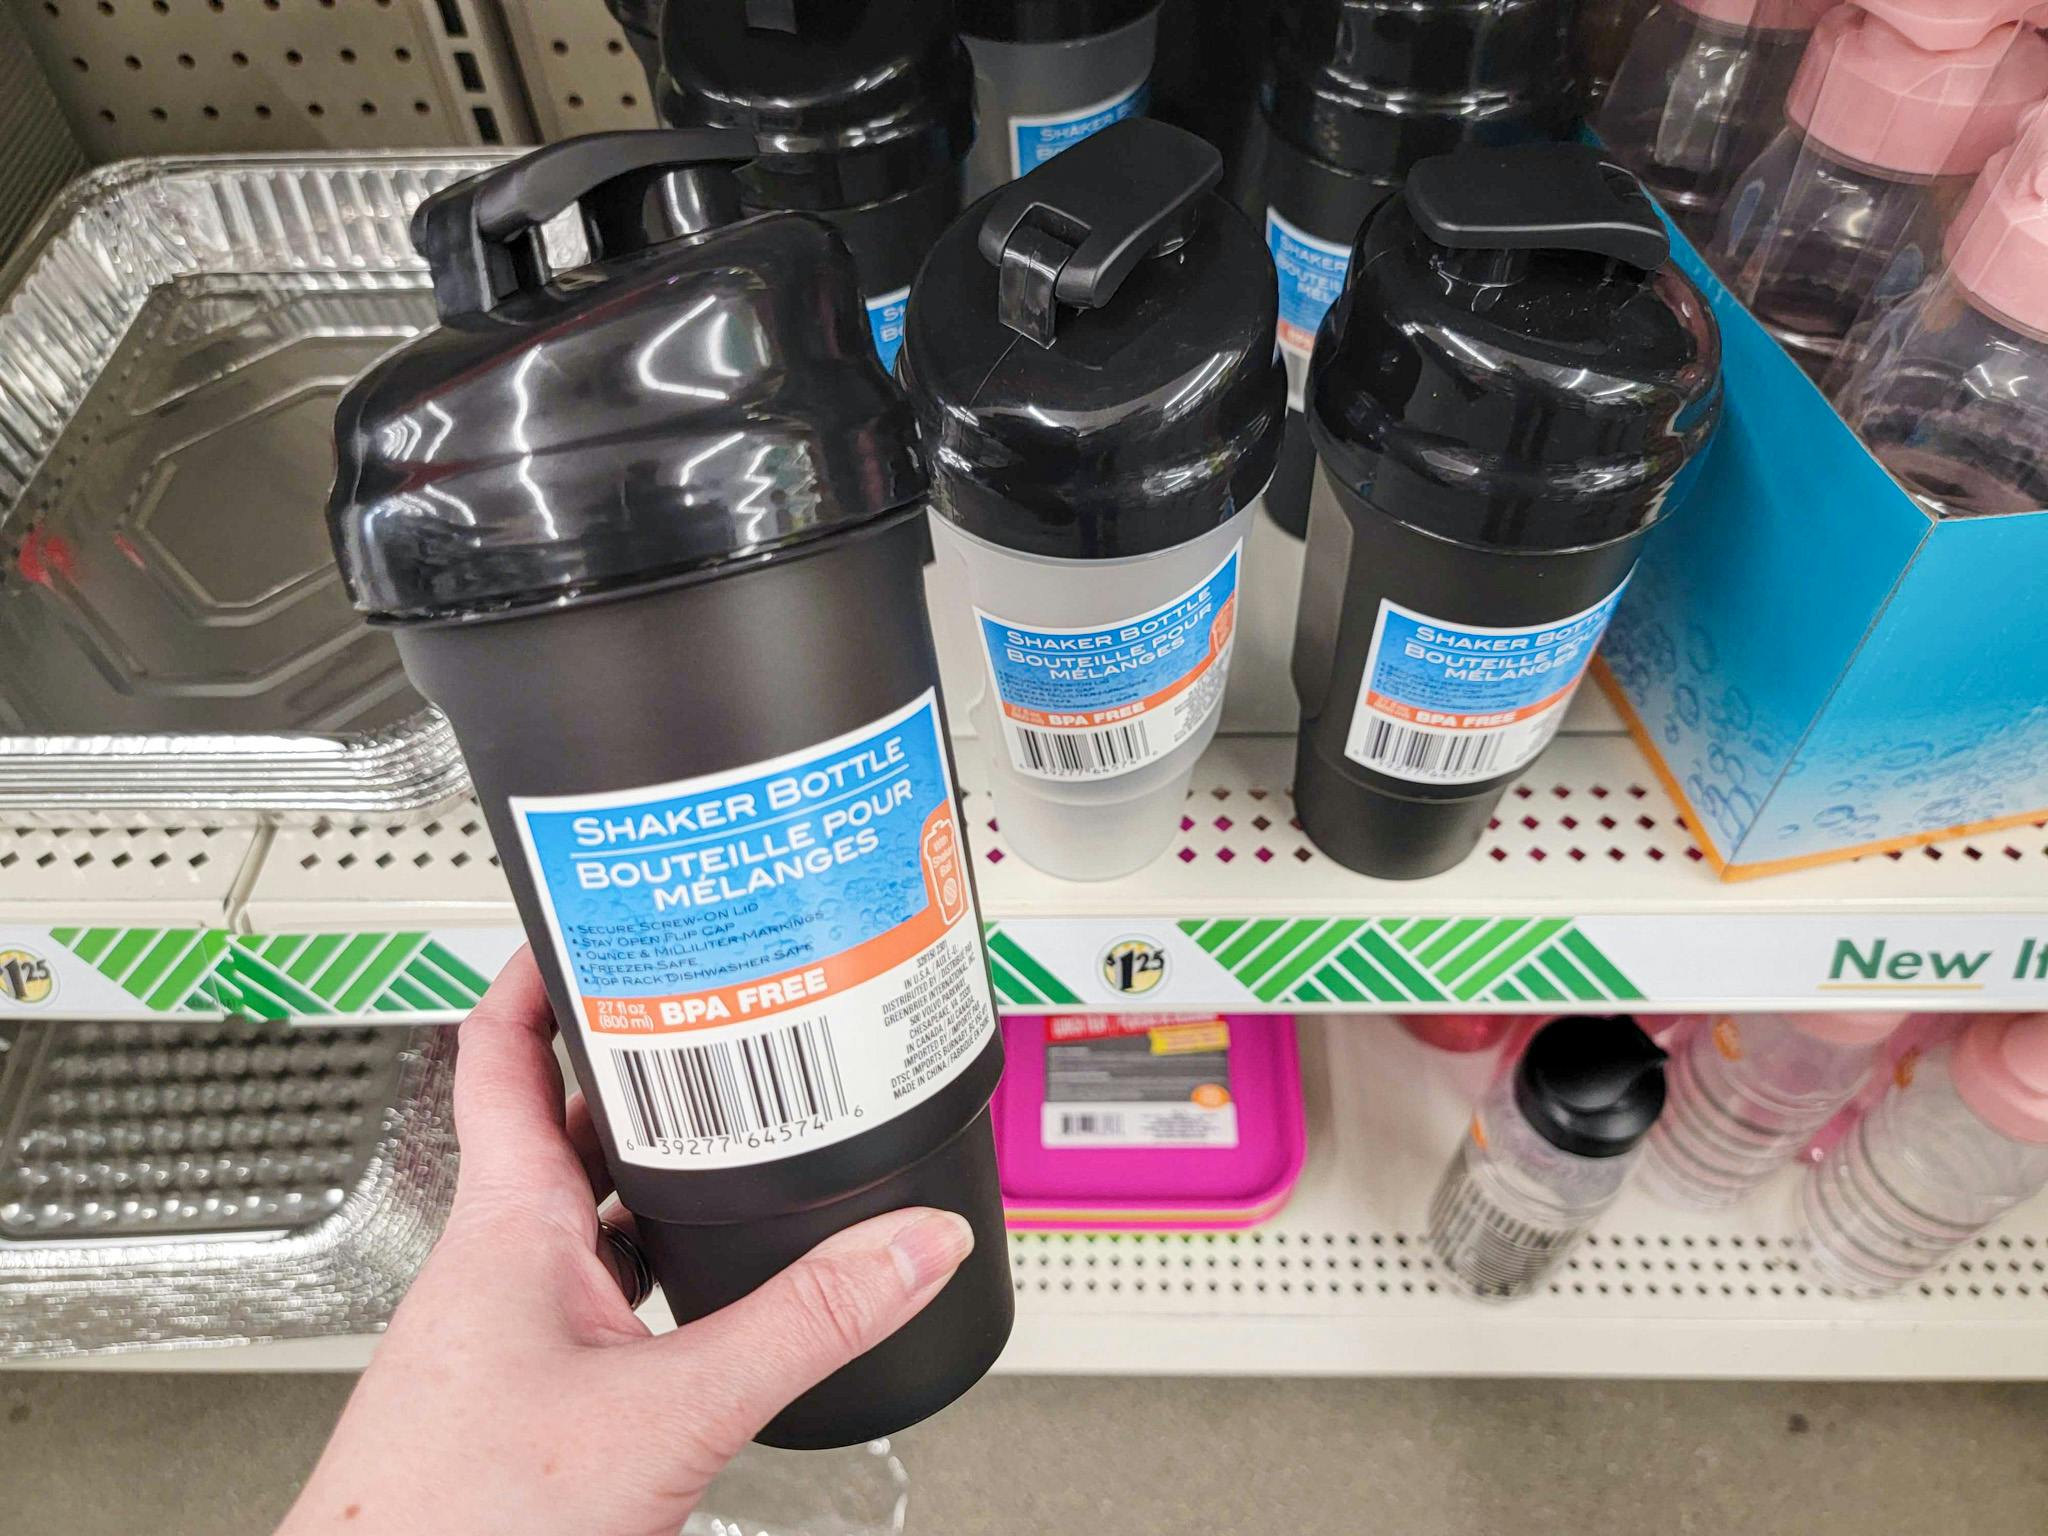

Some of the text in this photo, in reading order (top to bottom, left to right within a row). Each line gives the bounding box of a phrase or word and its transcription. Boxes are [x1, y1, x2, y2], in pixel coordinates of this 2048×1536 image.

[1040, 114, 1114, 141] SHAKER
[1007, 630, 1112, 650] SHAKER
[1120, 586, 1210, 641] BOTTLE
[1007, 643, 1146, 668] BOUTEILLE
[1152, 603, 1211, 648] POUR
[1416, 626, 1530, 651] SHAKER
[1050, 636, 1185, 680] MÉLANGES
[1404, 642, 1551, 669] BOUTEILLE
[1048, 702, 1146, 726] BPA FREE
[1415, 711, 1517, 727] BPA FREE
[572, 736, 905, 846] SHAKER BOTTLE
[576, 779, 913, 890] BOUTEILLE POUR
[653, 828, 880, 912] MÉLANGES
[577, 902, 759, 935] SECURE SCREW-ON LID
[582, 922, 735, 948] STAY OPEN FLIP CAP
[586, 950, 637, 961] OUNCE
[655, 935, 738, 958] MILLILITER
[742, 911, 824, 941] MARKINGS
[590, 957, 698, 974] FREEZER SAFE
[593, 943, 815, 986] TOP RACK DISHWASHER SAFE
[1828, 937, 1993, 979] New
[597, 1001, 613, 1014] 27
[628, 1003, 647, 1015] oz
[660, 967, 828, 1026] BPA FREE
[882, 981, 928, 1015] DISTRIBUTED
[884, 994, 927, 1027] GREENBRIER
[631, 1015, 654, 1031] ml)
[906, 1042, 915, 1054] IN
[916, 1023, 943, 1048] CANADA
[904, 1039, 939, 1068] IMPORTED
[912, 1050, 942, 1076] IMPORTS
[893, 1079, 916, 1100] MADE
[917, 1074, 926, 1087] IN
[926, 1060, 947, 1081] CHINA
[627, 1105, 864, 1155] 6 39277 64574 6
